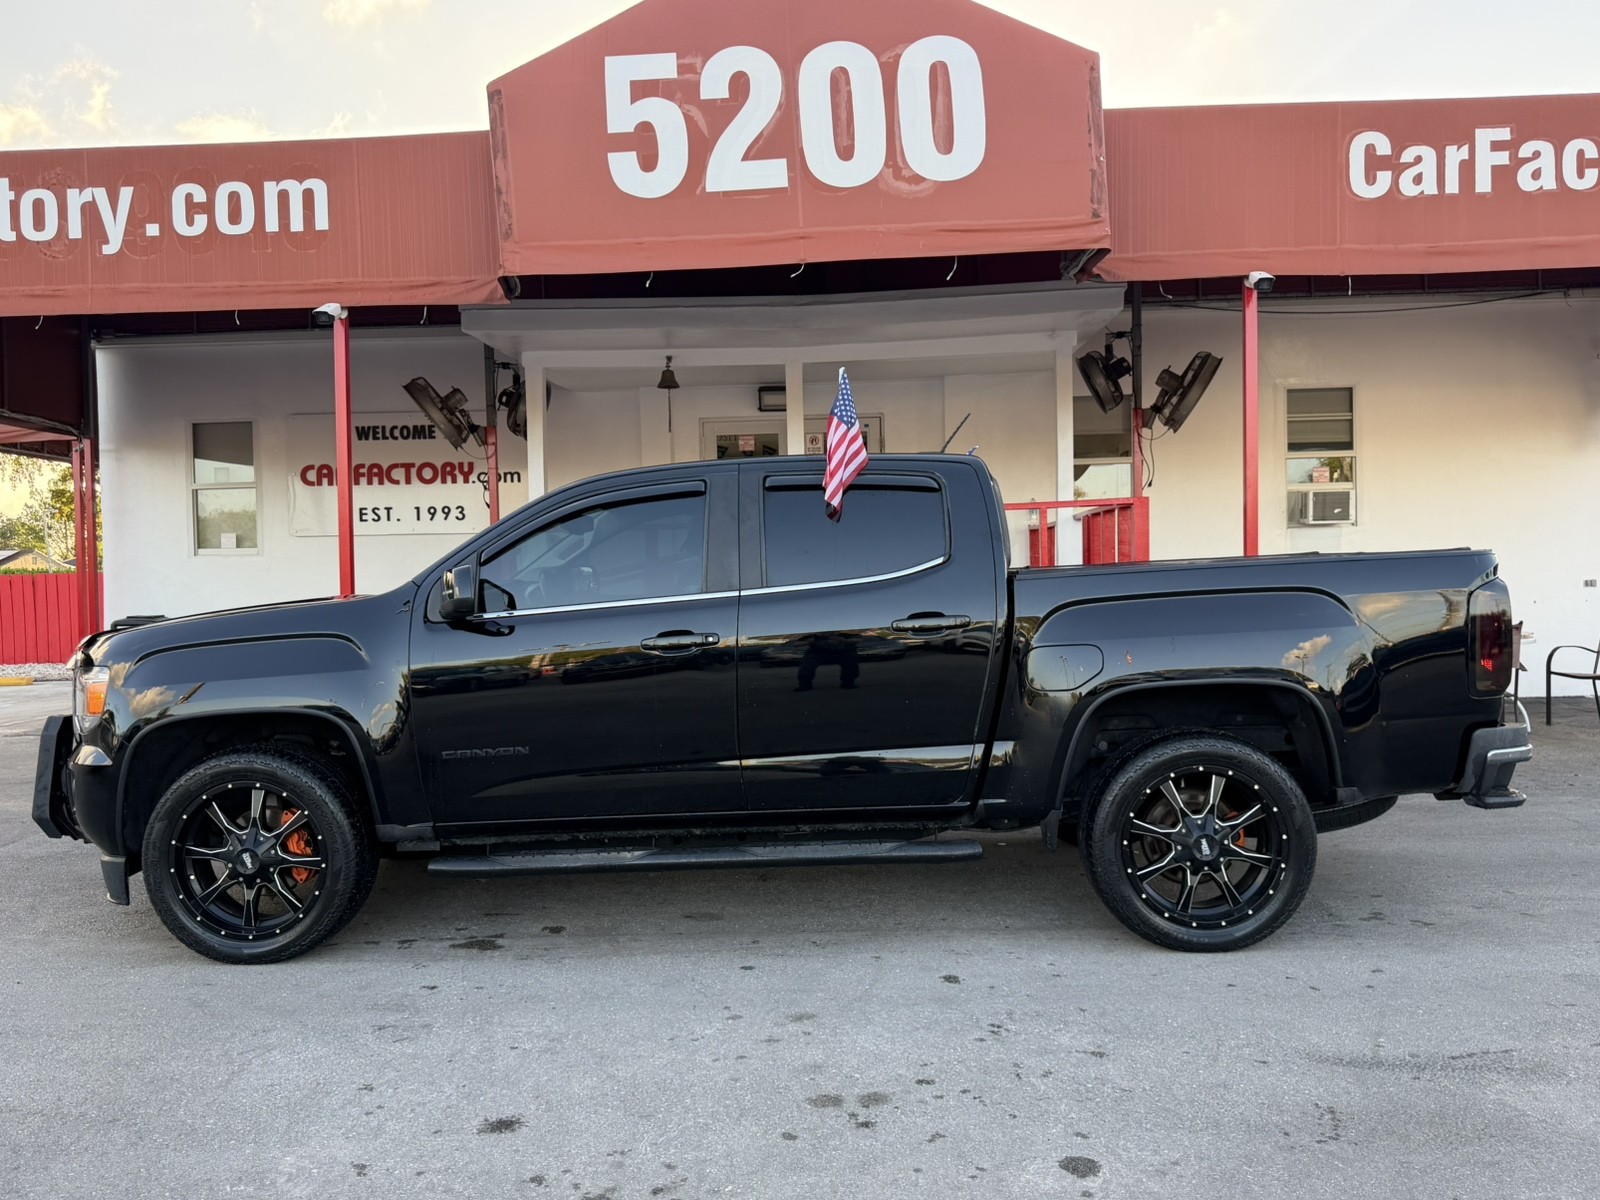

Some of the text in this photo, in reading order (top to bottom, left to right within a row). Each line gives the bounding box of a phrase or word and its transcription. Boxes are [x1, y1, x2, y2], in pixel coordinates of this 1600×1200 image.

[604, 34, 987, 199] 5200
[1348, 126, 1600, 199] CarFac
[355, 424, 437, 441] WELCOME
[299, 461, 522, 487] CAFACTORY.cm
[358, 505, 467, 523] EST. 1993
[441, 746, 530, 760] CANYON
